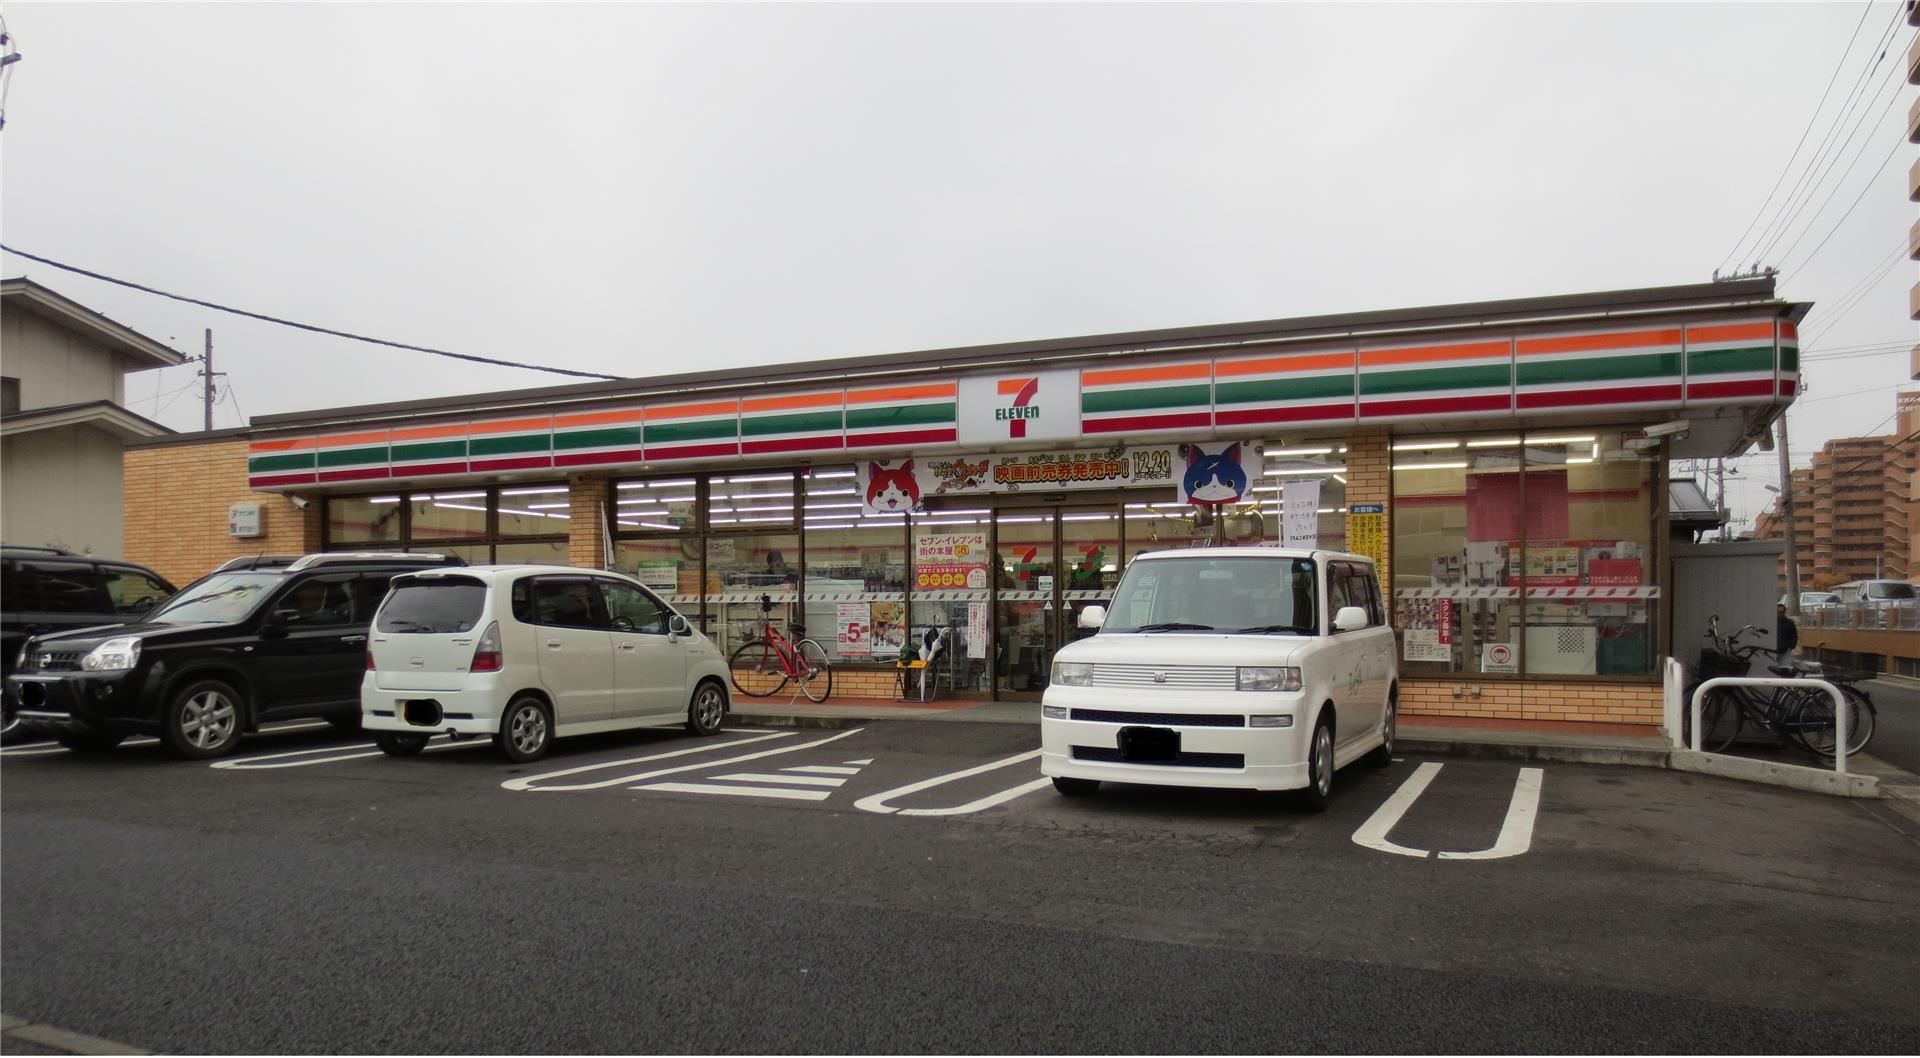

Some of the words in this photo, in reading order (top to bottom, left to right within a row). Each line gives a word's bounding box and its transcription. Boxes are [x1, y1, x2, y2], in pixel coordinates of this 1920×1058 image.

[998, 377, 1038, 438] 7
[1133, 450, 1171, 474] 12.20
[920, 546, 953, 556] 街の本屋
[848, 622, 861, 643] 5
